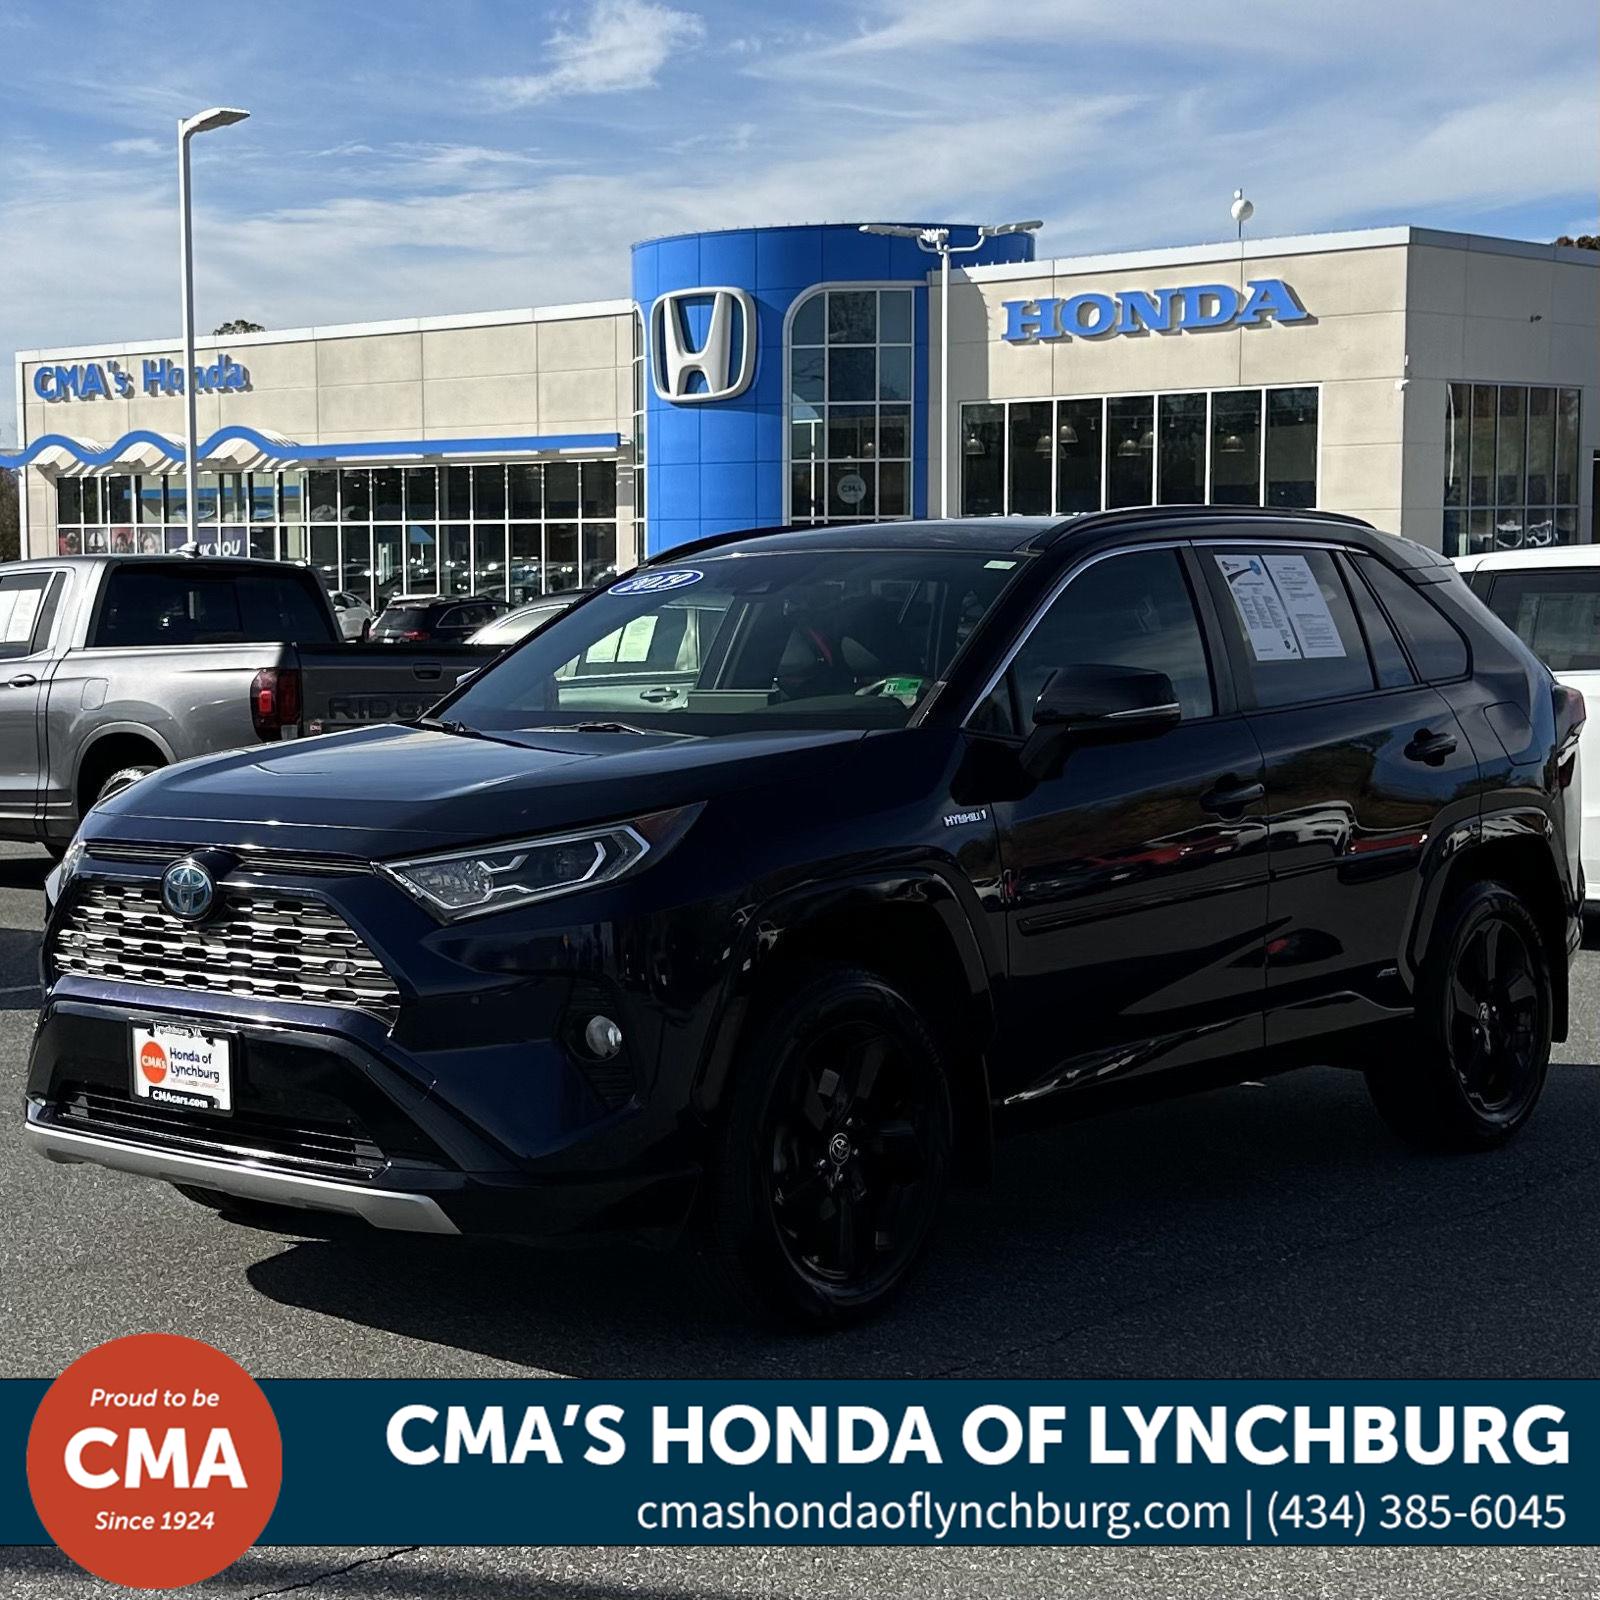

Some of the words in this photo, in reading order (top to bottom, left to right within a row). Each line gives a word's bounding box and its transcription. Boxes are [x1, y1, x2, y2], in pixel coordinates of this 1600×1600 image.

[1001, 278, 1309, 341] HONDA
[34, 360, 130, 400] CMA's
[142, 354, 247, 393] Honda
[329, 697, 432, 719] RIDG
[141, 1054, 167, 1070] CMA's
[169, 1046, 201, 1063] Honda
[201, 1053, 212, 1065] of
[170, 1062, 220, 1083] Lynchburg
[152, 1090, 209, 1109] CMAcars.com
